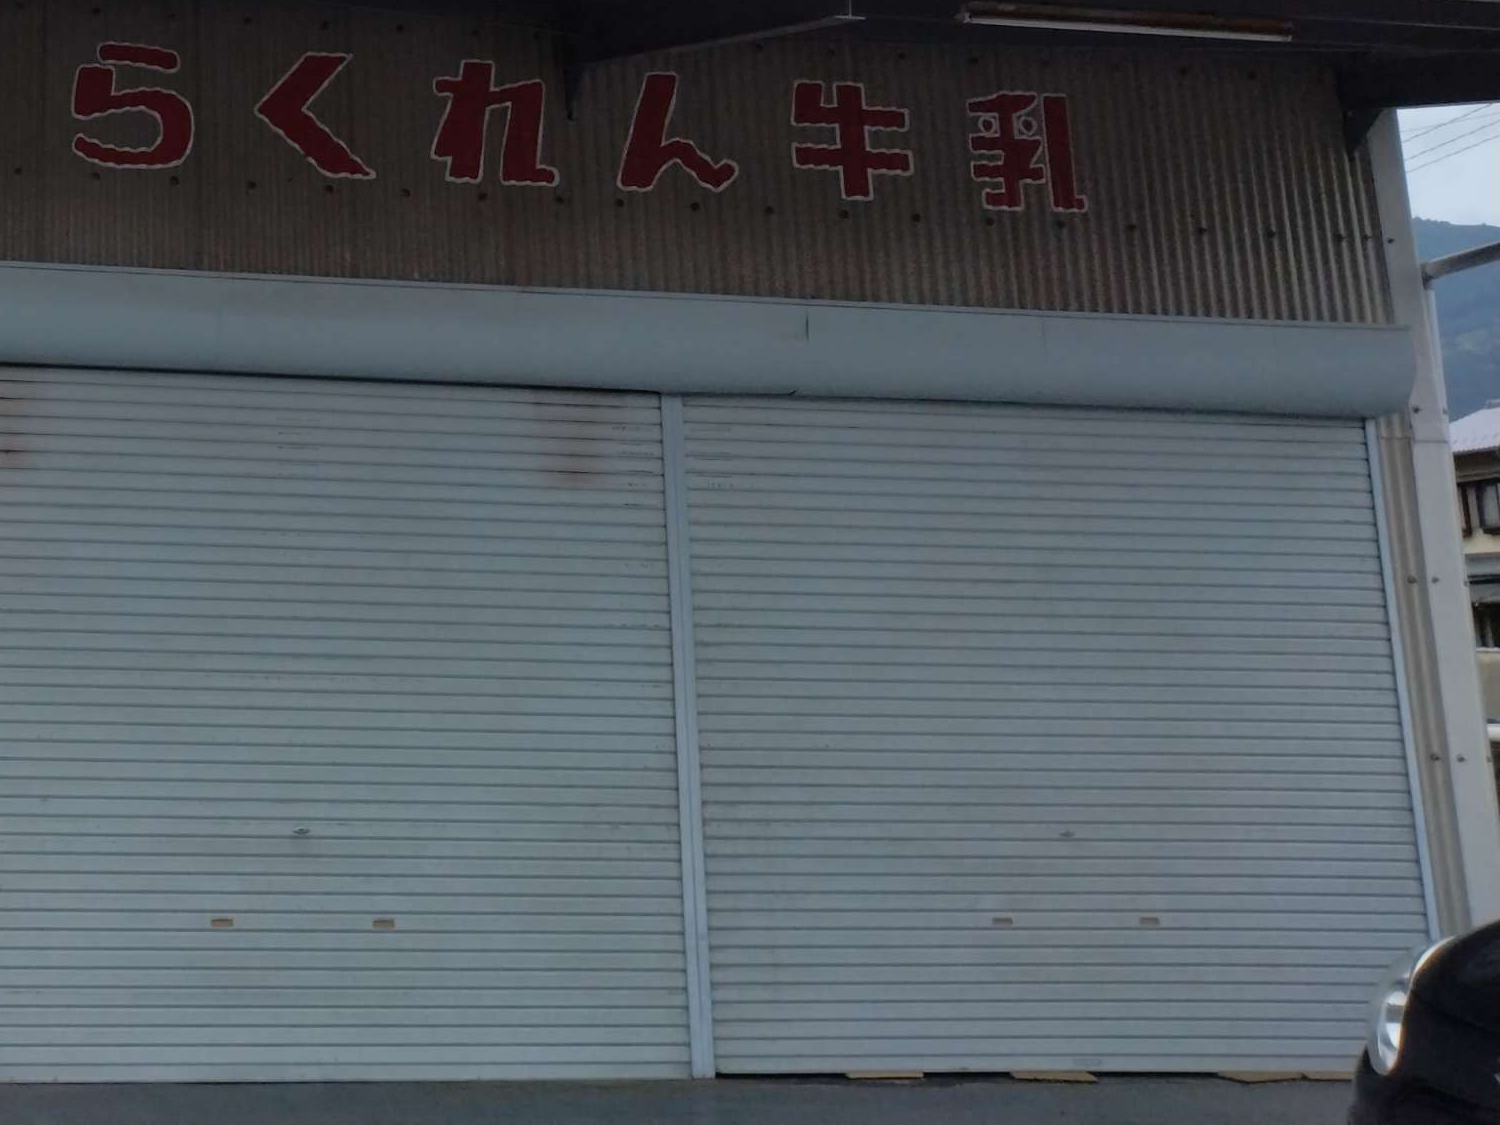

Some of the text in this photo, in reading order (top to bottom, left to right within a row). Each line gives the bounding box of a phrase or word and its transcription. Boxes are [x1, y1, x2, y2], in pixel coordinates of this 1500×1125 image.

[71, 41, 1089, 213] らくれん牛乳
